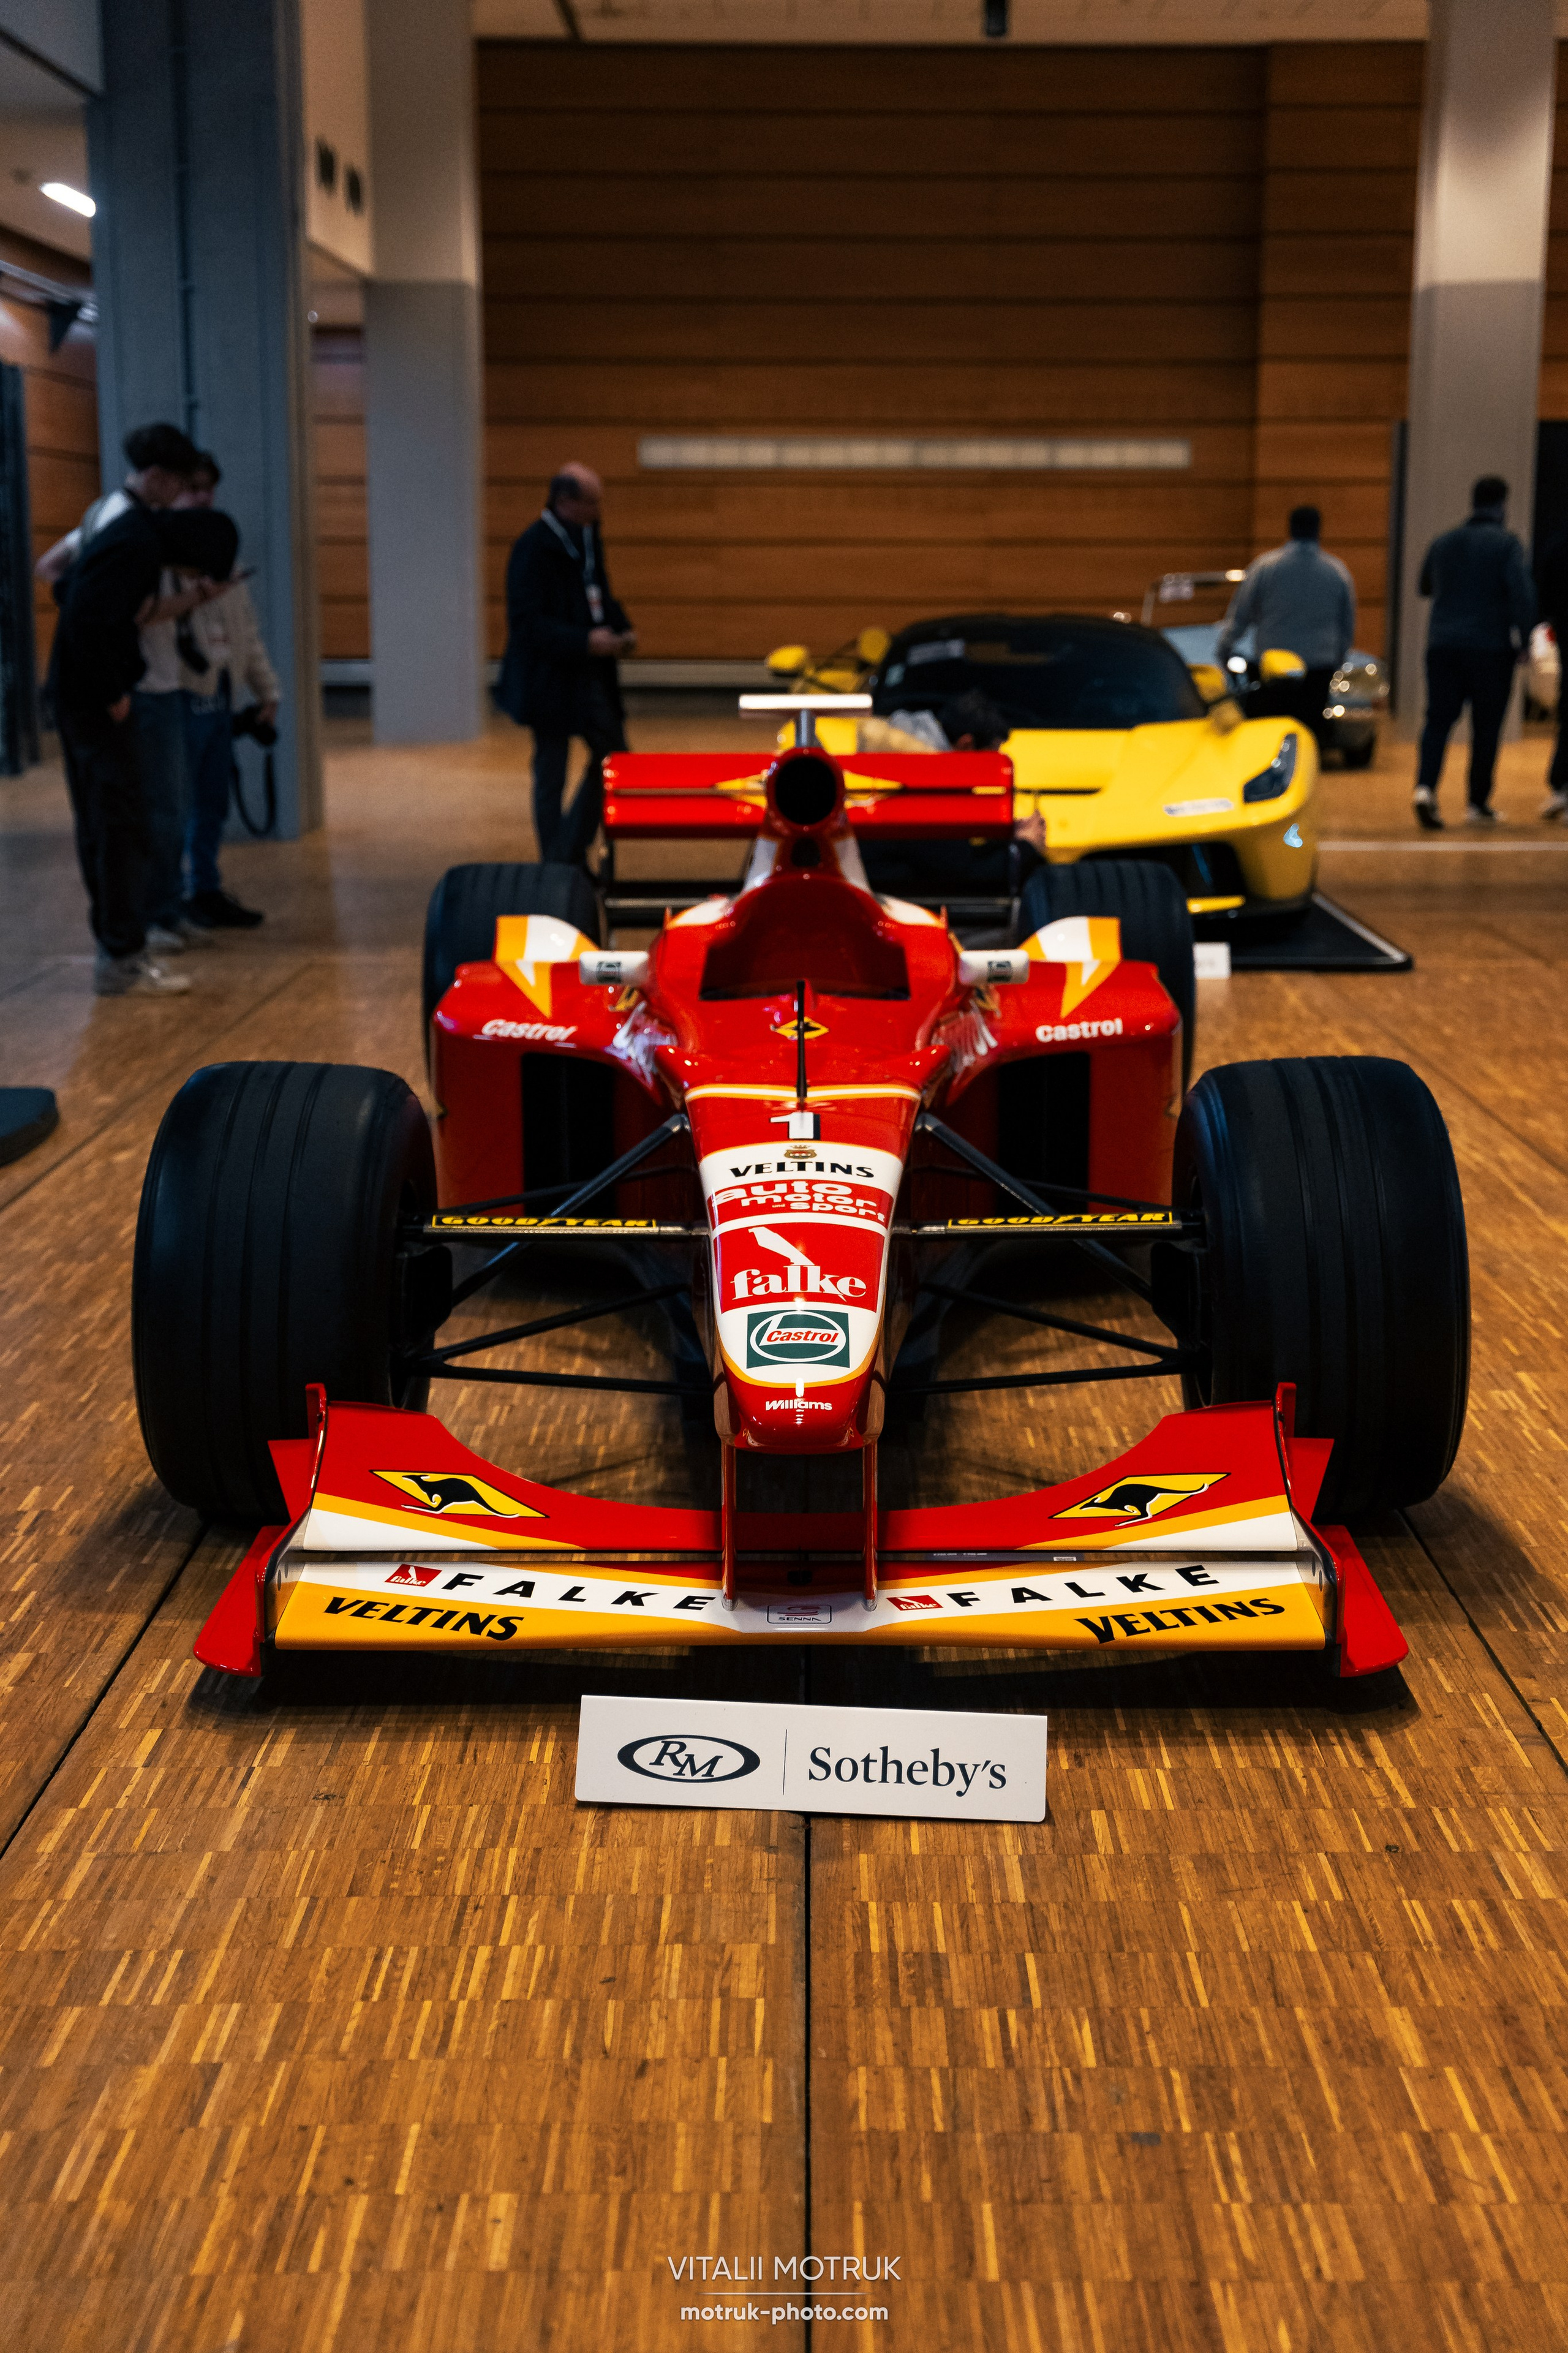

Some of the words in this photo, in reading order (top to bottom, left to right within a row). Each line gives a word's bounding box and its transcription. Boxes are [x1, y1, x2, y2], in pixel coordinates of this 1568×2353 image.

[481, 1018, 578, 1042] Castrol
[1035, 1017, 1123, 1043] Castrol
[770, 1111, 821, 1140] 1
[729, 1161, 875, 1178] VELTINS
[712, 1180, 853, 1207] auto
[741, 1193, 878, 1207] motor
[790, 1201, 886, 1223] sport
[957, 1213, 1165, 1225] GOODYEAR
[730, 1265, 867, 1302] falke
[766, 1330, 839, 1343] Castrol
[765, 1398, 833, 1411] Williams
[389, 1575, 426, 1586] falke
[440, 1573, 717, 1611] FALKE
[945, 1563, 1219, 1608] FALKE
[323, 1597, 524, 1641] VELTINS
[1074, 1598, 1286, 1644] VELTINS
[648, 1740, 723, 1778] RM
[808, 1745, 1007, 1797] Sotheby's
